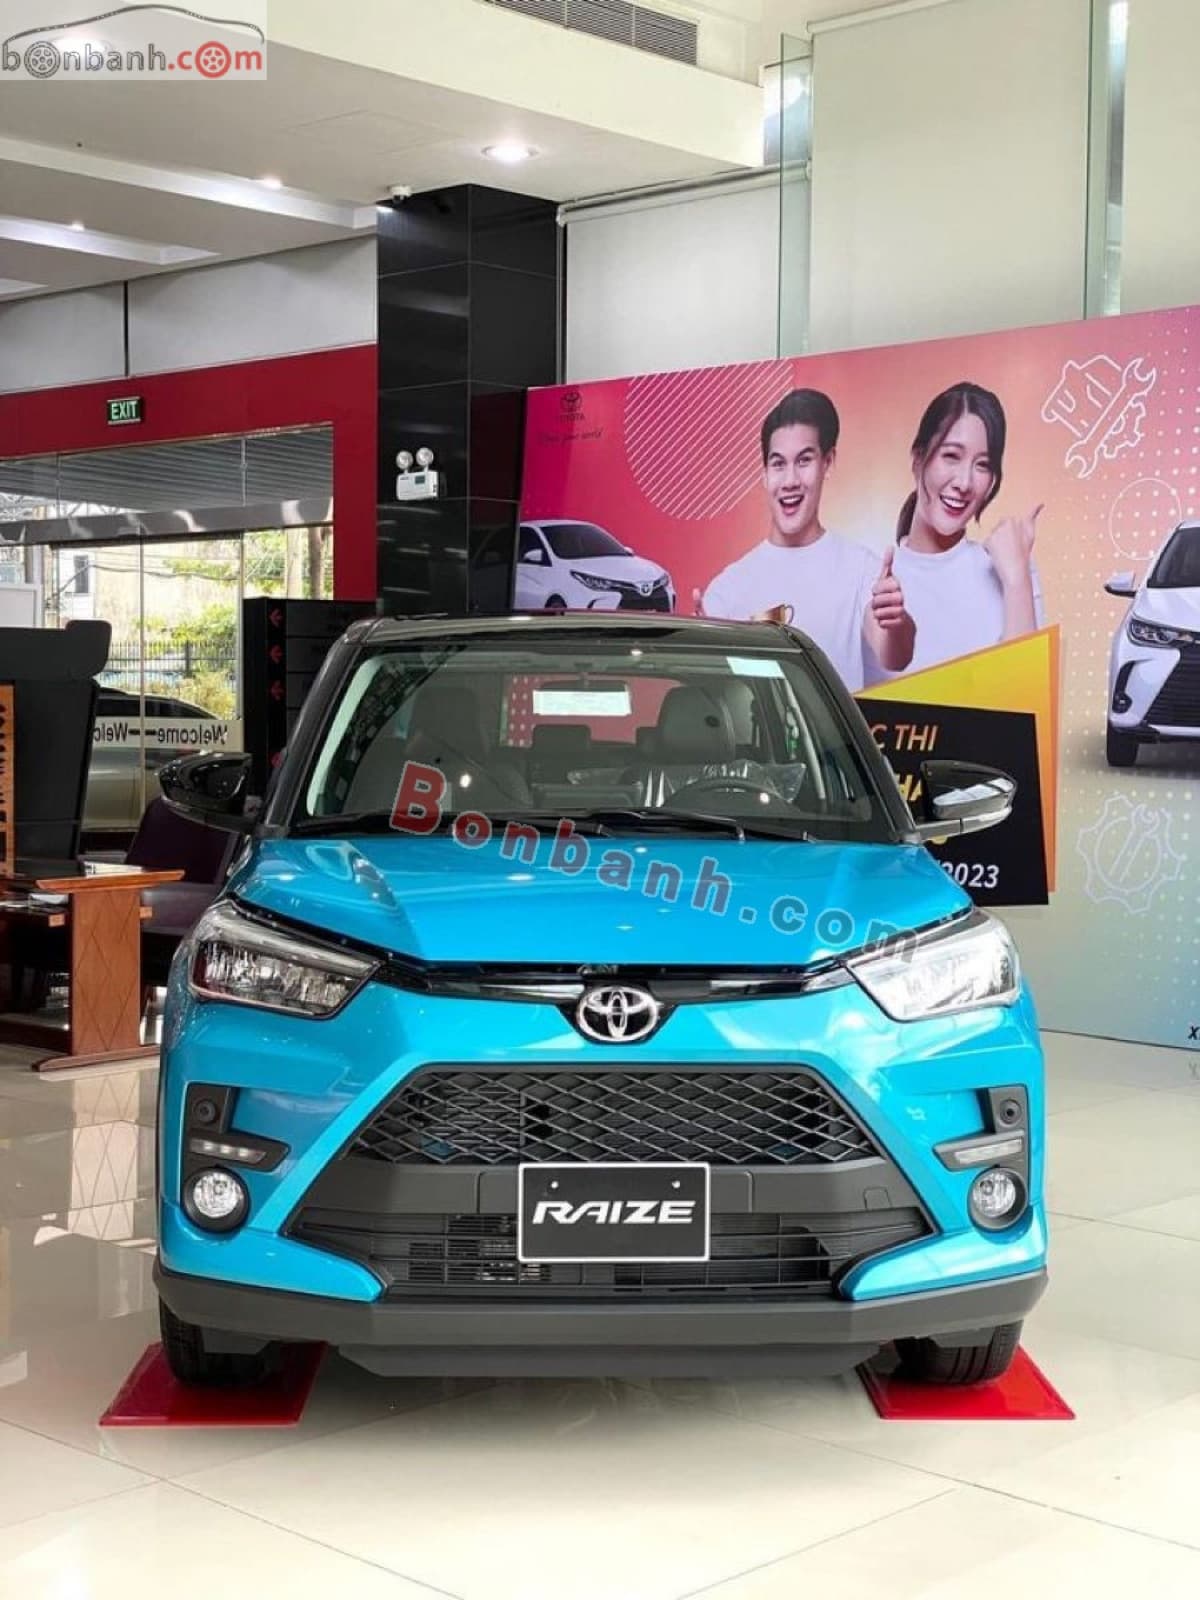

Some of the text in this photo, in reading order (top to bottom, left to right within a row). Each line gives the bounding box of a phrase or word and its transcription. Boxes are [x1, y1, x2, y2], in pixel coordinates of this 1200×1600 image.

[111, 401, 137, 419] EXIT
[895, 725, 938, 751] THI
[532, 1200, 696, 1224] RAIZE
